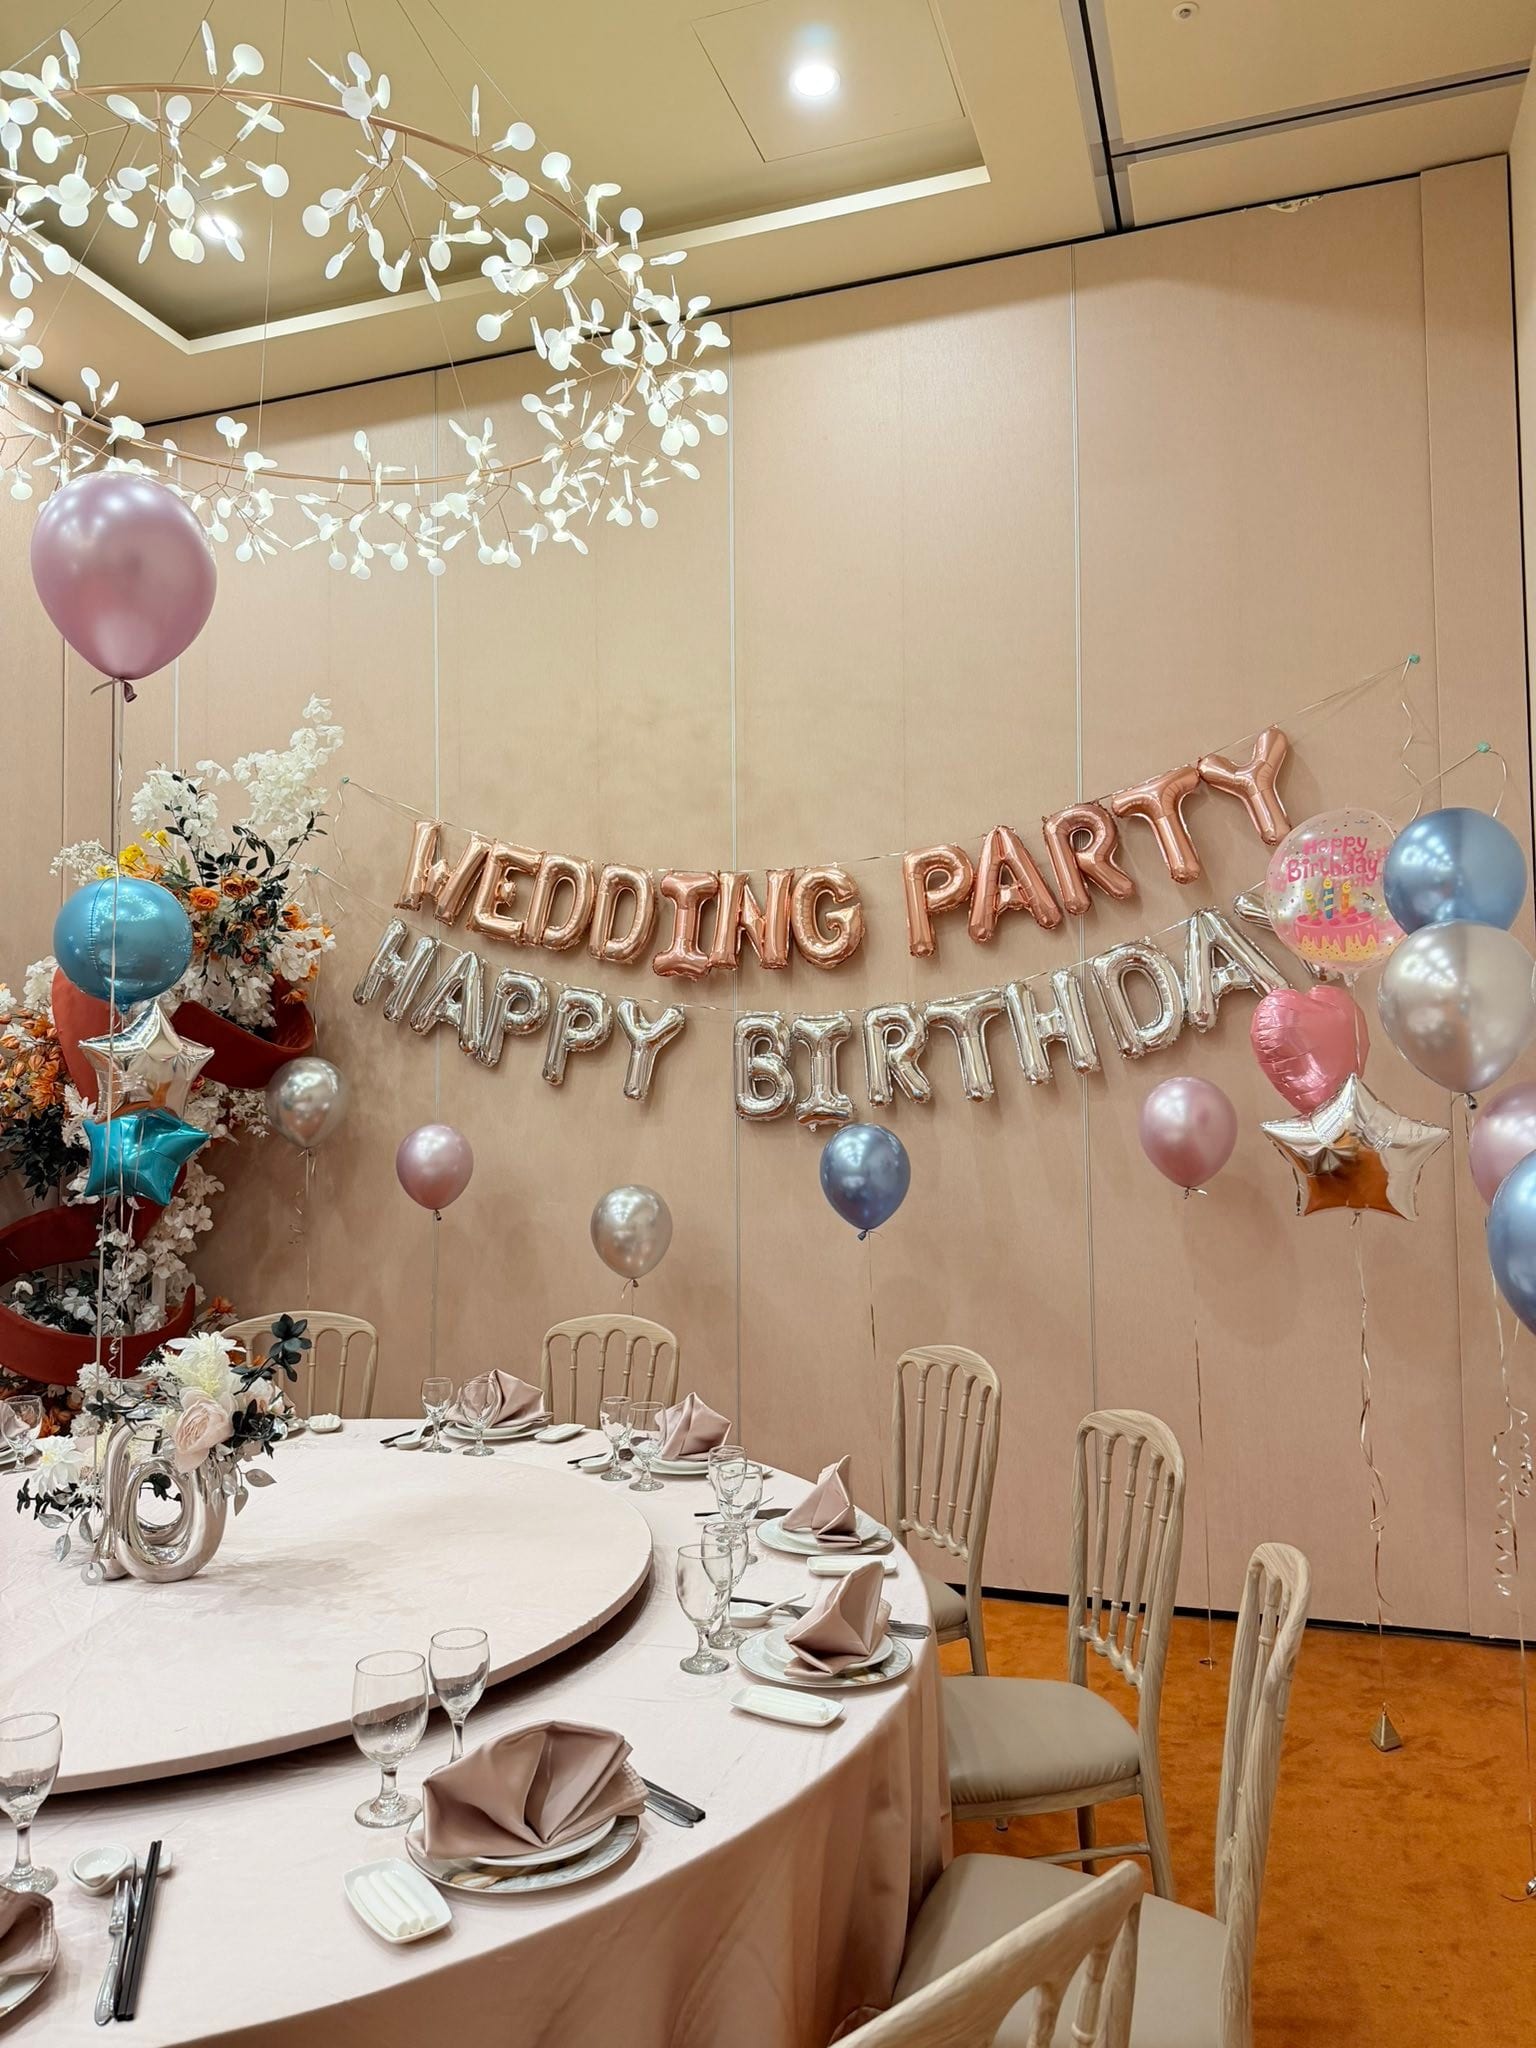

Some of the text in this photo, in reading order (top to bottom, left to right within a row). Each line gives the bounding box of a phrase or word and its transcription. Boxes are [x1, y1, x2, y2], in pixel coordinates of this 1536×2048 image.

[394, 725, 1291, 981] WEDDING PARTY
[1286, 856, 1378, 882] Birthday
[1302, 836, 1367, 856] Happy
[353, 917, 689, 1101] HAPPY
